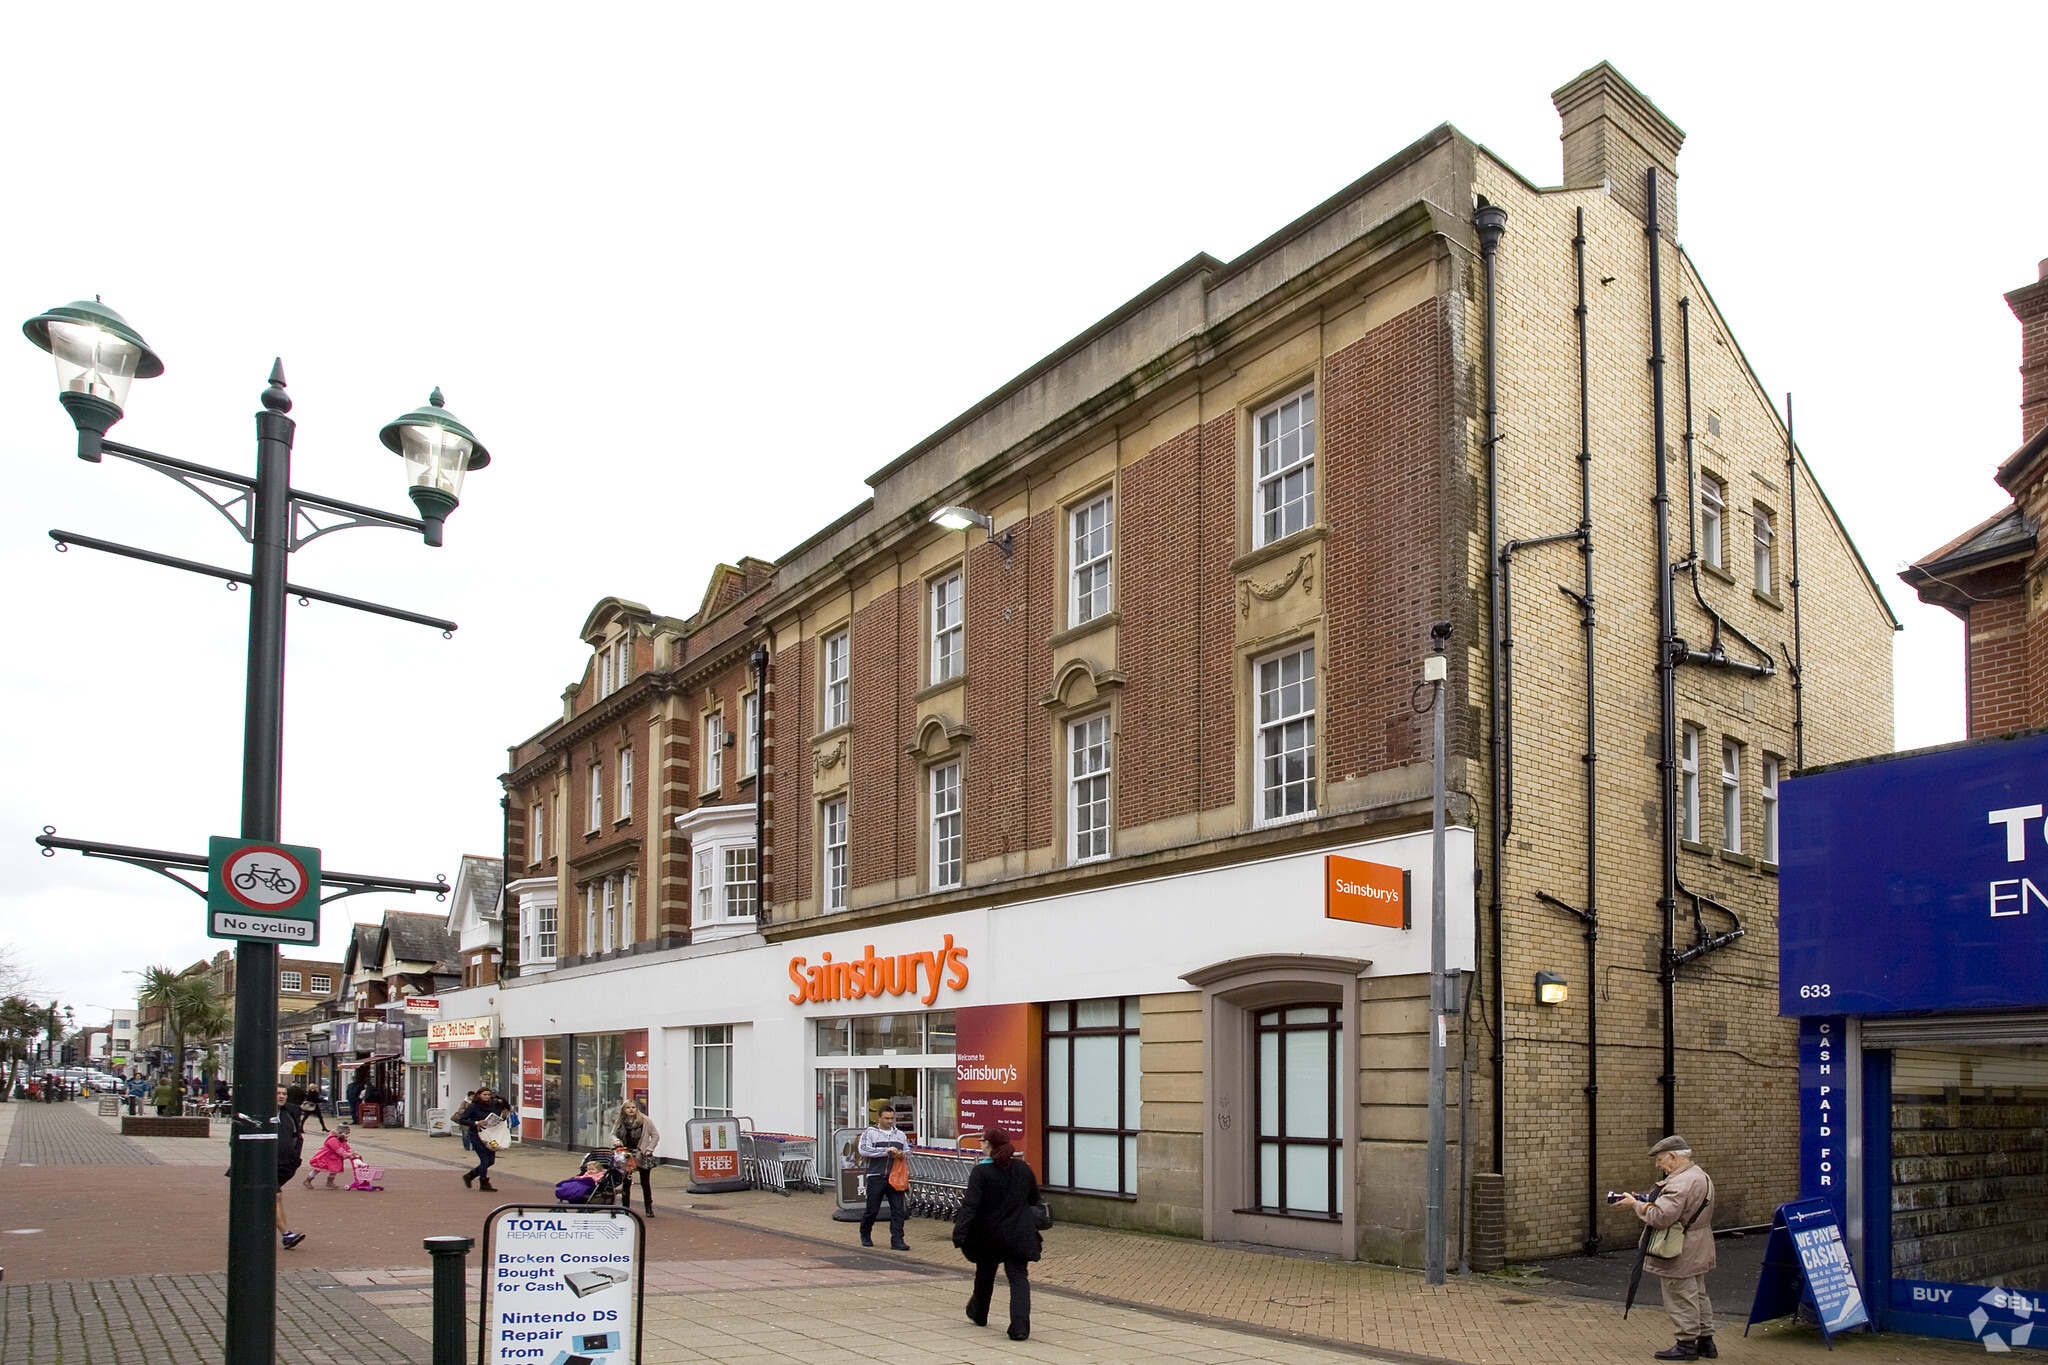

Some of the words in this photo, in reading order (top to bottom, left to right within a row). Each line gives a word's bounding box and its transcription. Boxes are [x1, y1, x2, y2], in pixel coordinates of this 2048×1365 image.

[1988, 804, 2048, 862] T
[1336, 879, 1399, 903] Sainsbury's
[223, 917, 247, 930] No
[252, 921, 306, 936] cycling
[789, 934, 970, 1006] Sainsbury's
[1800, 985, 1831, 998] 633
[1819, 1024, 1831, 1074] CASH
[957, 1054, 978, 1062] Welcome
[979, 1053, 985, 1061] to
[957, 1064, 1017, 1084] Sainsbury's
[1820, 1086, 1831, 1137] PAID
[699, 1161, 733, 1171] FREE
[1821, 1148, 1832, 1185] FOR
[507, 1219, 567, 1231] TOTAL
[507, 1231, 547, 1240] REPAIR
[550, 1231, 594, 1240] CENTRE
[1795, 1233, 1813, 1248] WE
[1813, 1228, 1831, 1244] PAY
[499, 1254, 555, 1264] Broken
[560, 1253, 630, 1263] Consoles
[498, 1267, 555, 1280] Bought
[497, 1282, 520, 1292] for
[525, 1281, 564, 1291] Cash
[1913, 1287, 1953, 1303] BUY
[1994, 1294, 2046, 1312] SELL
[502, 1311, 586, 1324] Nintendo
[593, 1310, 618, 1322] DS
[501, 1329, 563, 1343] Repair
[501, 1347, 544, 1358] from
